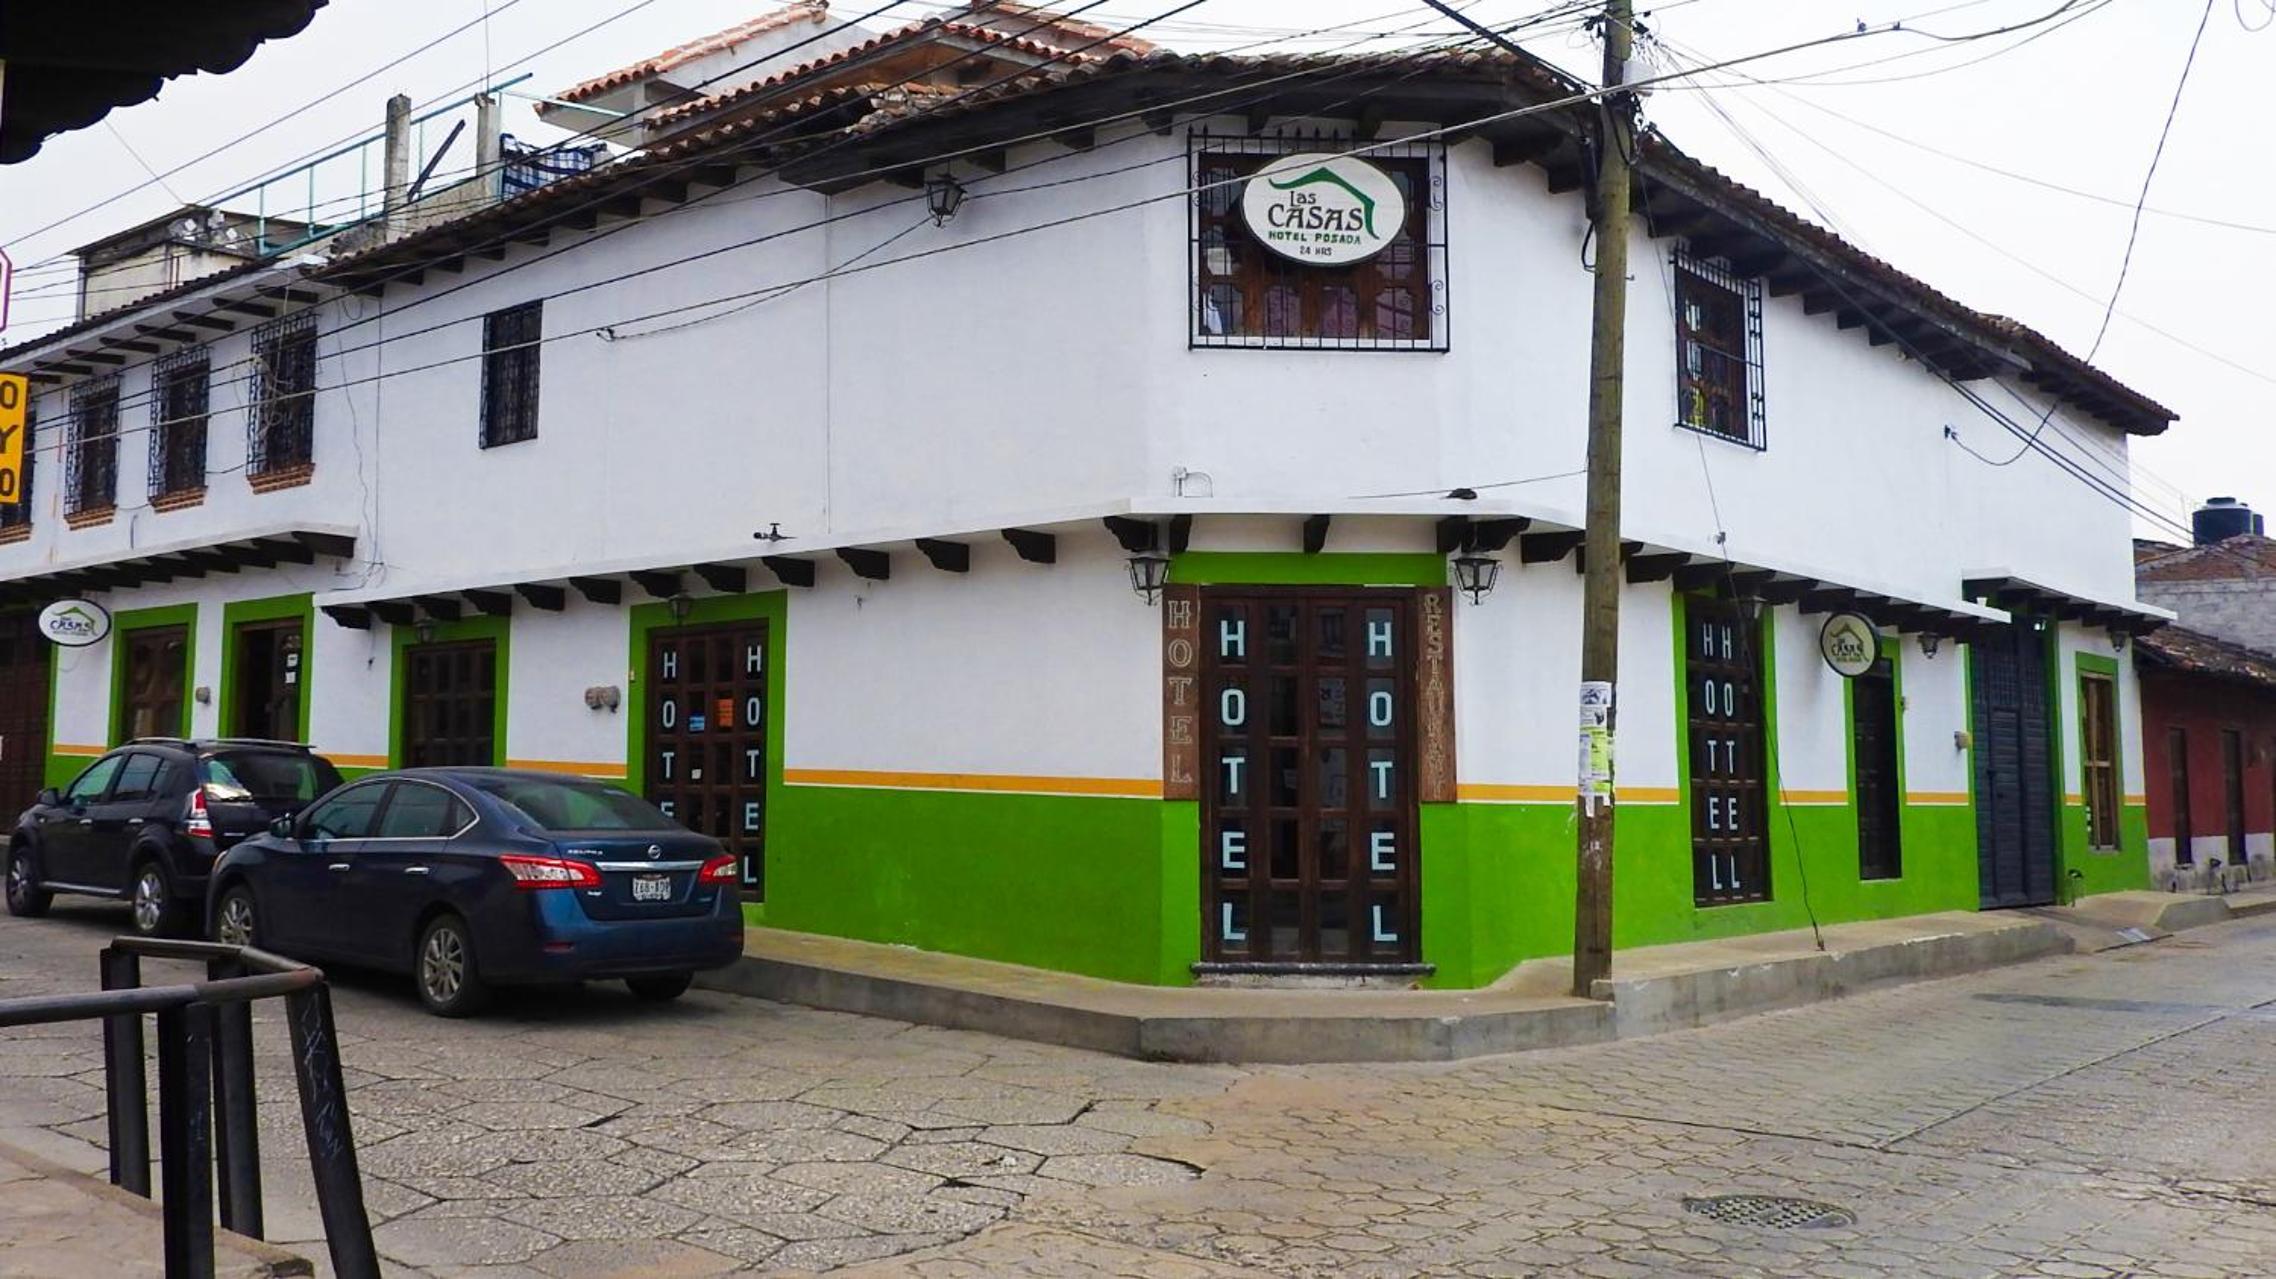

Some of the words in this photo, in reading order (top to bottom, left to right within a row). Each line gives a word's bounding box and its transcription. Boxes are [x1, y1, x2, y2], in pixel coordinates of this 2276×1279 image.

[1268, 203, 1363, 231] CASAS
[1269, 231, 1307, 241] HOTEL
[1314, 233, 1361, 245] POSADA
[1299, 246, 1311, 255] 24
[1315, 247, 1332, 256] HRS
[744, 645, 762, 884] HOTEL
[1168, 600, 1192, 783] HOTEL
[1220, 620, 1246, 942] HOTEL
[1368, 621, 1398, 942] HOTEL
[1703, 623, 1723, 890] HOTEL
[1721, 625, 1740, 889] HOTEL
